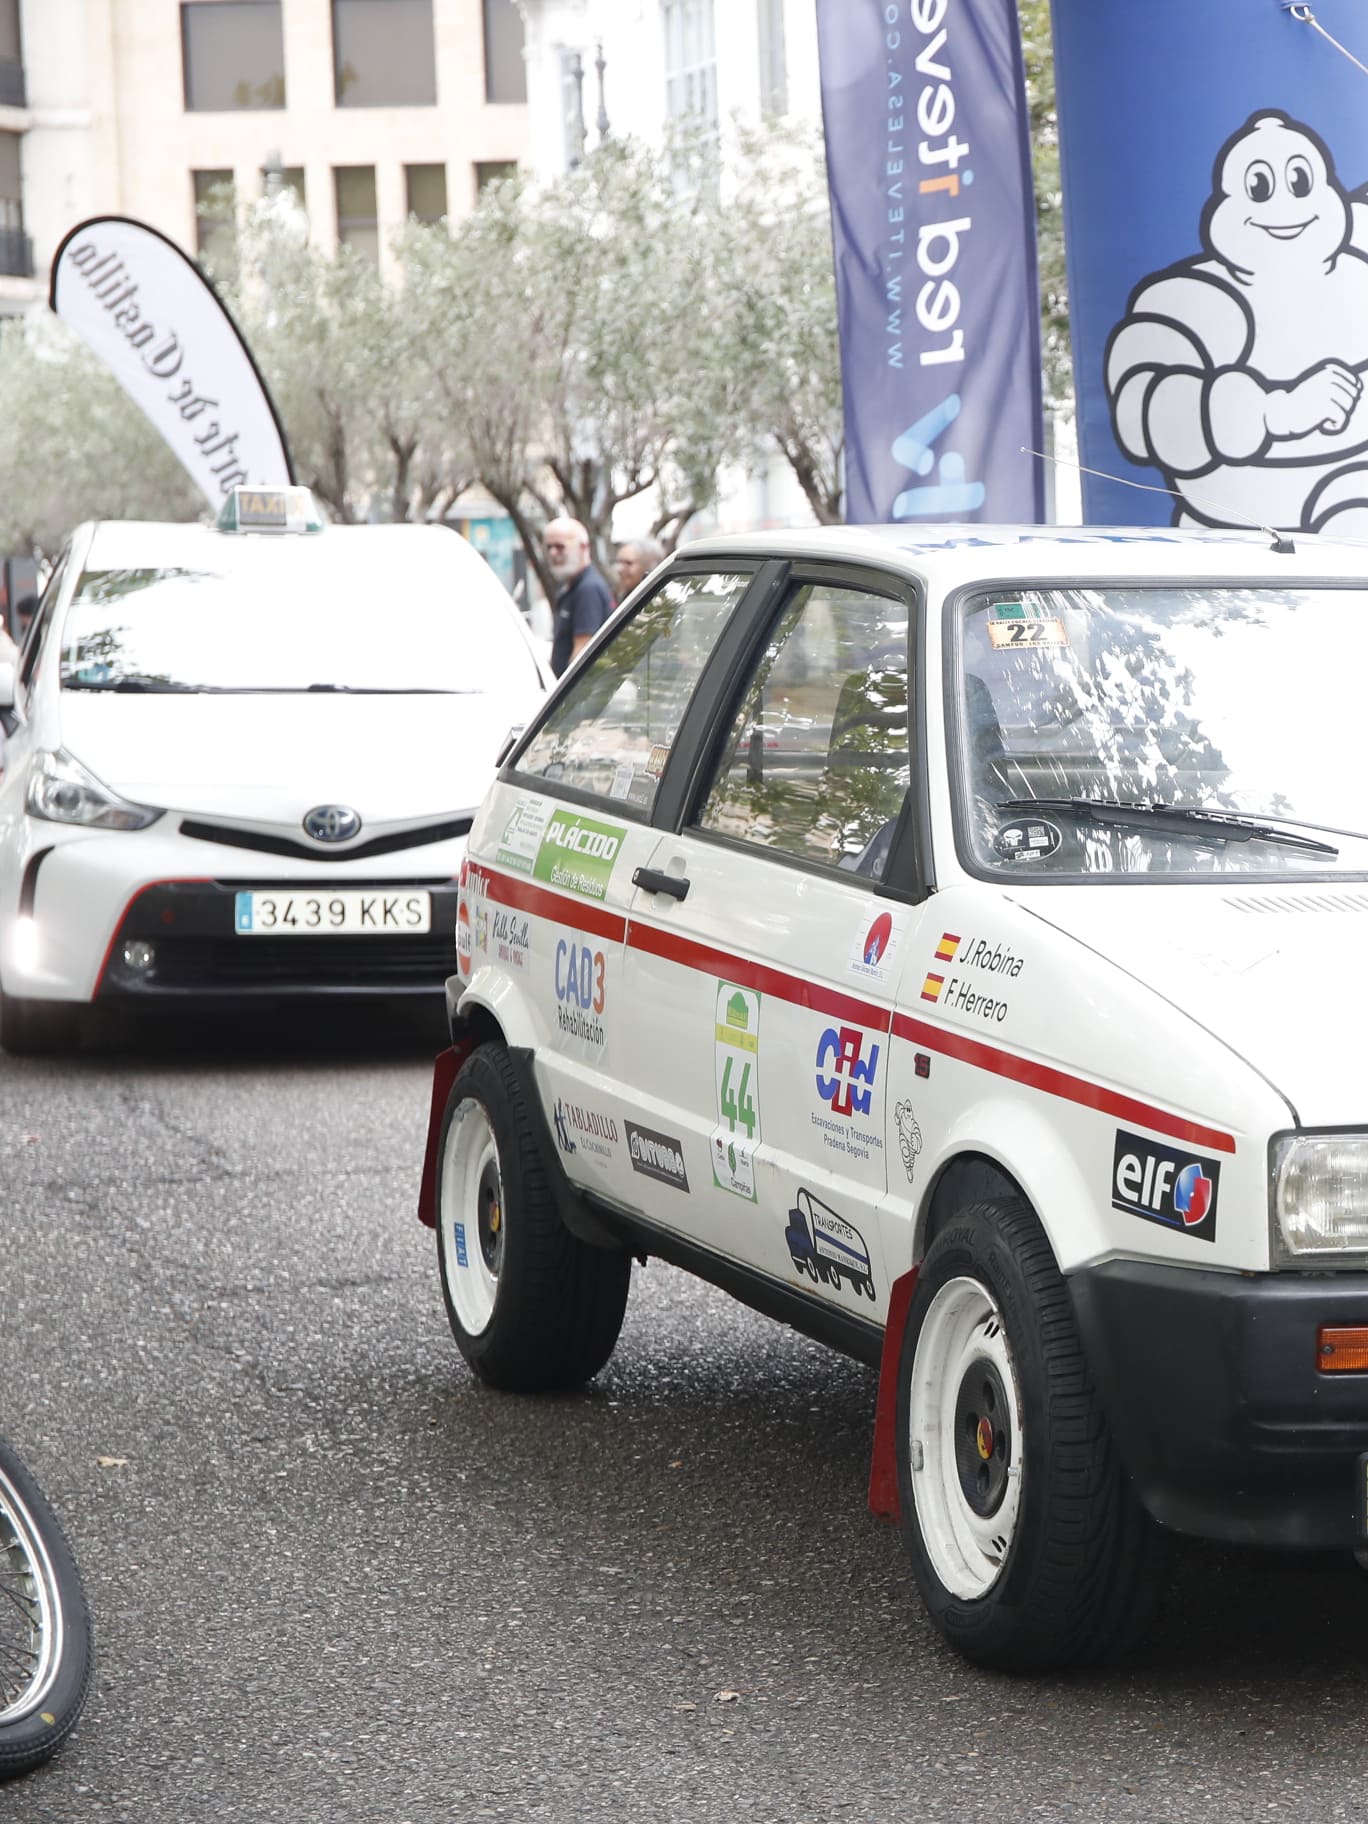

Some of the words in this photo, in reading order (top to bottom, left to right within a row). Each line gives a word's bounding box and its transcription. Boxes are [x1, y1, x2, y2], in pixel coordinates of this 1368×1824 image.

[1007, 623, 1047, 642] 22
[545, 818, 619, 861] PLÁCIDO
[550, 864, 571, 887] Gestión
[570, 872, 579, 889] de
[260, 899, 346, 927] 3439
[360, 898, 422, 927] KKS
[555, 937, 605, 1015] CAD3
[959, 937, 1024, 978] J.Robina
[943, 977, 1008, 1023] F.Herrero
[557, 1005, 605, 1046] Rehabilitación
[720, 1055, 756, 1141] 44
[565, 1103, 618, 1143] TABLADILLO
[811, 1112, 845, 1135] Excavaciones
[850, 1126, 883, 1149] Transportes
[846, 1142, 870, 1160] Segovia
[1116, 1153, 1176, 1211] elf
[814, 1212, 853, 1240] TRANSPORTES
